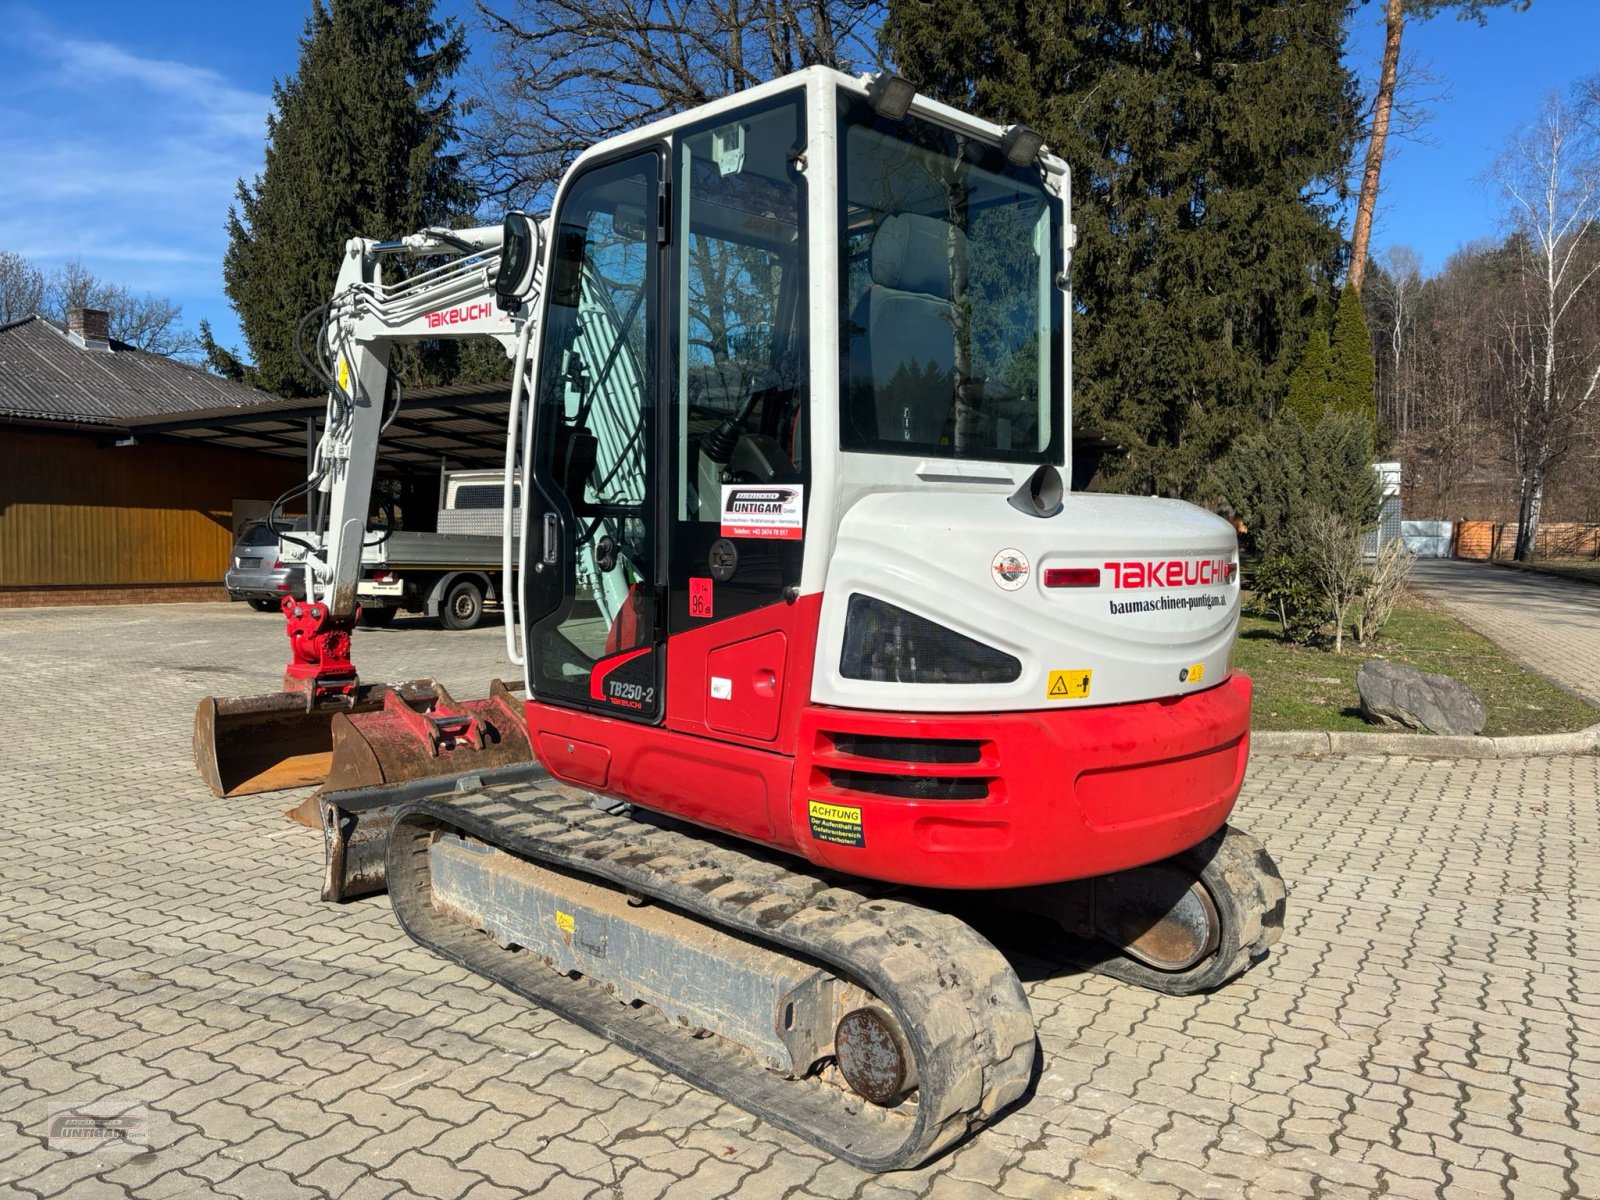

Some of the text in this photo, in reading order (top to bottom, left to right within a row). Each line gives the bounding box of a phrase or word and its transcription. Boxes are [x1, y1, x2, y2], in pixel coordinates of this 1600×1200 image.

[424, 302, 492, 328] TAKEUCHI
[1104, 560, 1224, 589] TAKEUCHI
[693, 594, 703, 613] 96
[1109, 594, 1227, 615] baumaschinen-puntigam.at
[609, 681, 654, 702] TB250-2
[609, 697, 642, 709] TAKEUCHI
[812, 806, 859, 820] ACHTUNG
[813, 826, 861, 838] Gefahrenbereich
[822, 820, 853, 831] Aufenthalt
